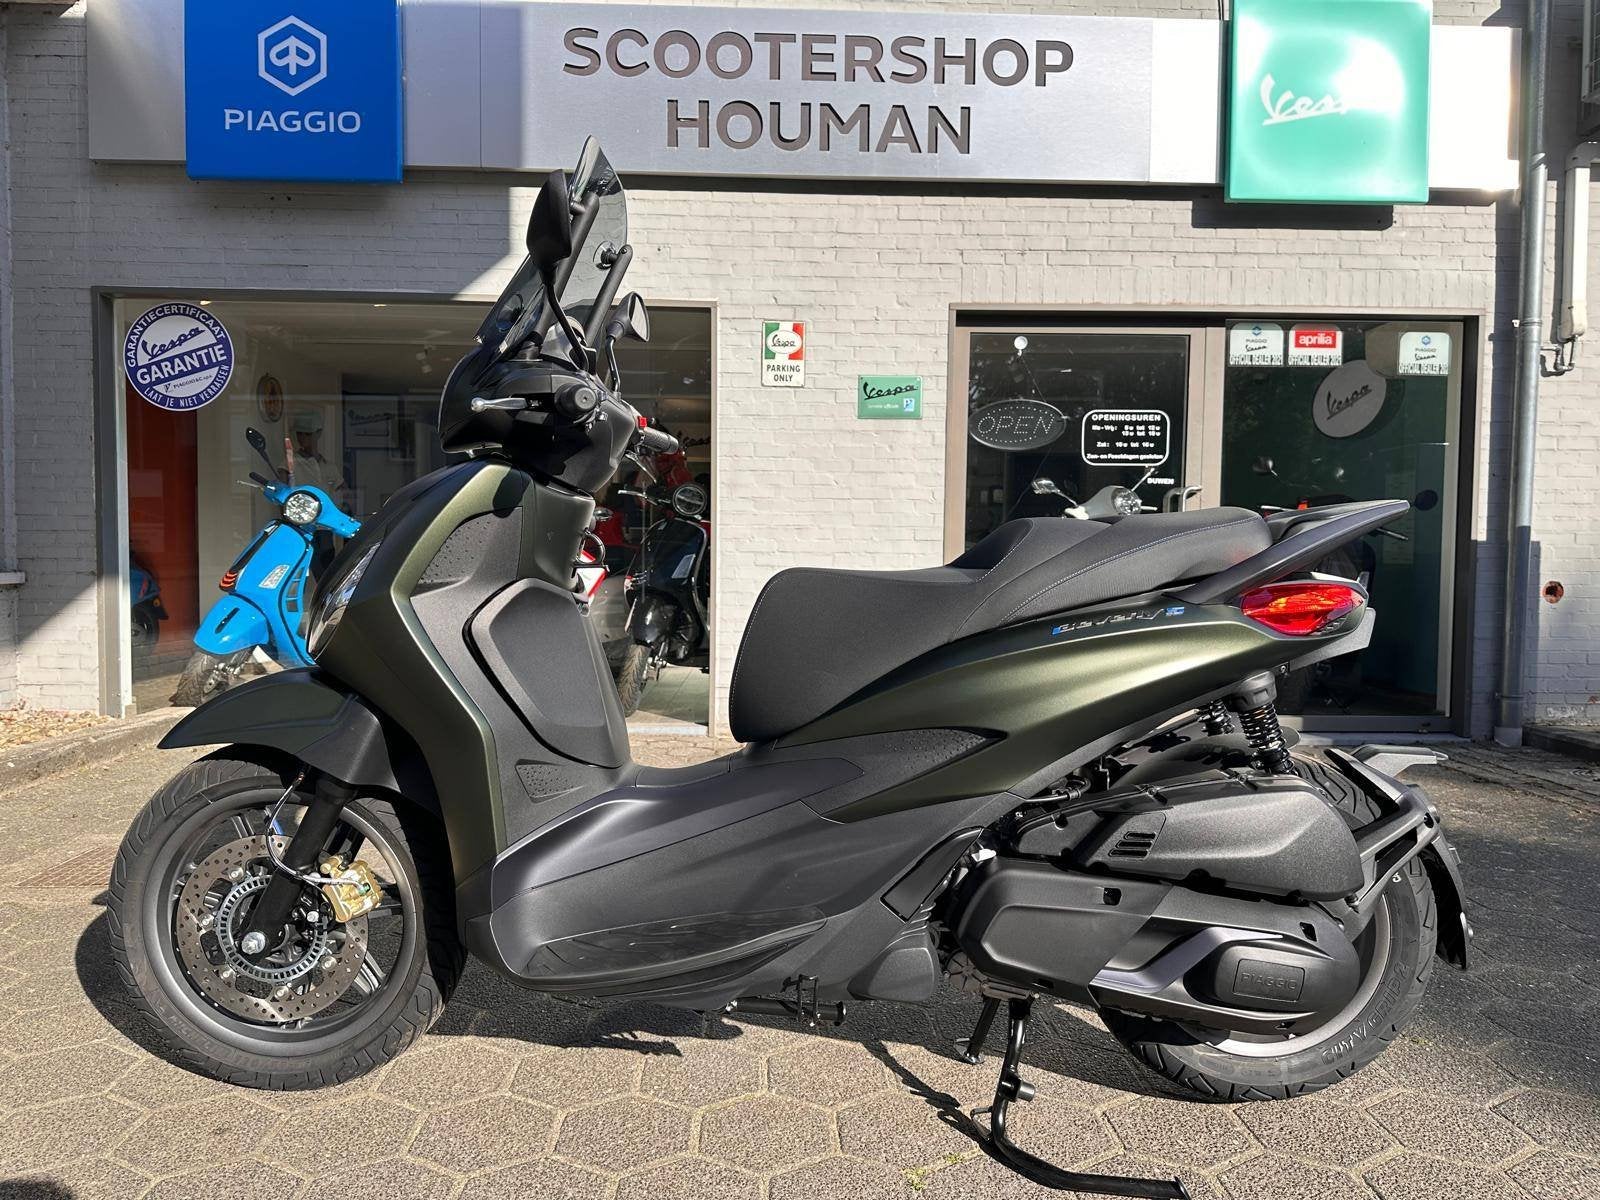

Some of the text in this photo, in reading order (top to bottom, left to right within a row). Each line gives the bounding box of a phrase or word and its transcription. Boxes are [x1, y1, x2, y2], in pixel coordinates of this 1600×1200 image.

[562, 27, 1074, 87] SCOOTERSHOP
[224, 109, 361, 134] PIAGGIO
[666, 98, 971, 154] HOUMAN
[127, 304, 226, 367] GARANTIECERTIFICAAT
[141, 327, 206, 361] Vespa
[771, 334, 796, 348] Vespa
[1299, 333, 1333, 346] aprilia
[137, 344, 227, 385] GARANTIE
[766, 364, 801, 373] PARKING
[144, 364, 230, 408] LAAT JE NIET VERRASSEN
[773, 374, 793, 382] ONLY
[863, 382, 919, 400] Vespa
[1326, 384, 1373, 420] Vespa
[977, 413, 1055, 434] OPEN
[1091, 413, 1161, 421] OPENINGSUREN
[1147, 477, 1174, 485] DUWEN
[1241, 972, 1298, 990] PIAGGIO
[1367, 977, 1401, 1031] GRIP
